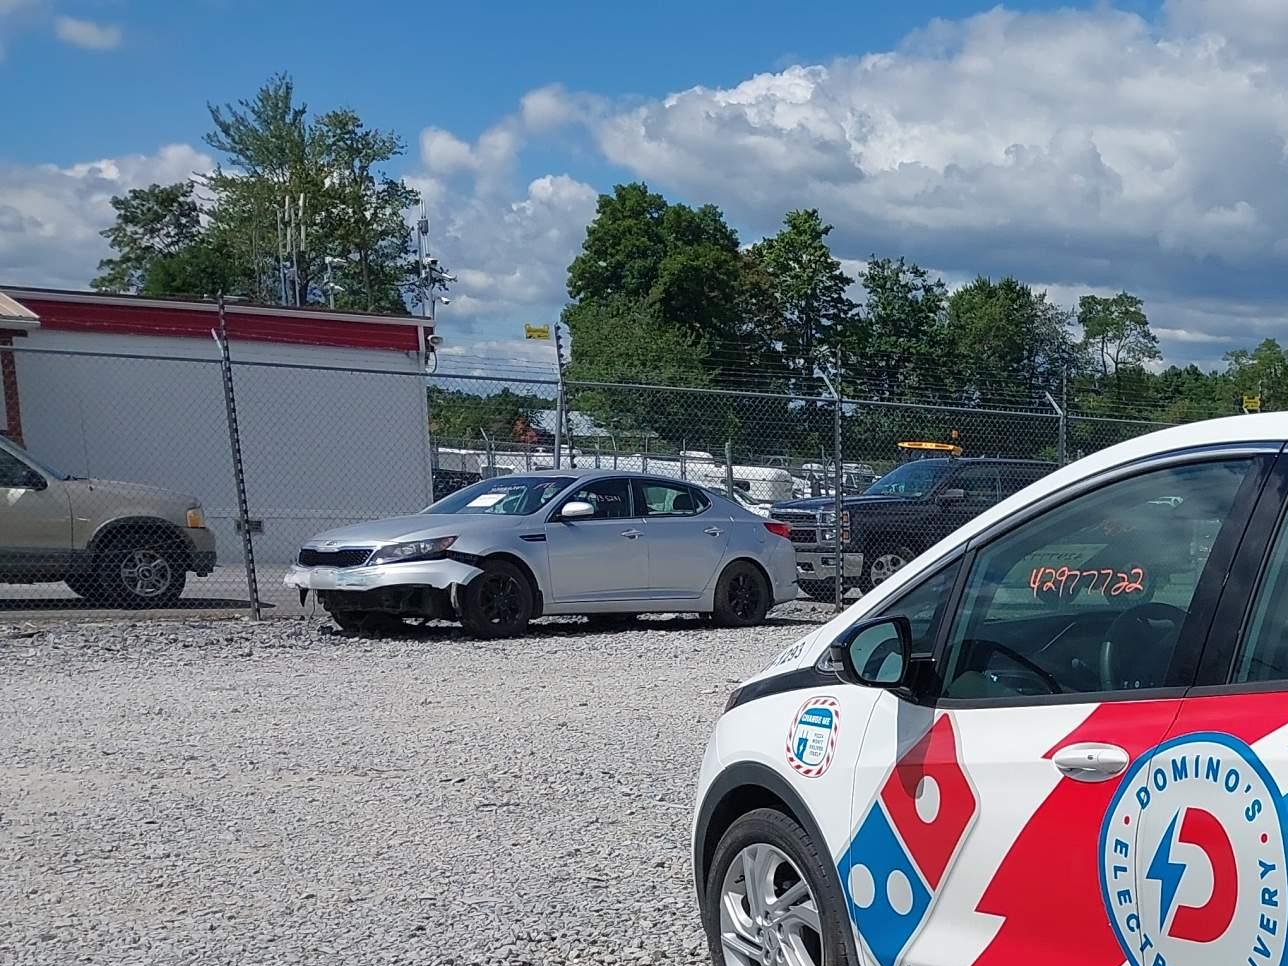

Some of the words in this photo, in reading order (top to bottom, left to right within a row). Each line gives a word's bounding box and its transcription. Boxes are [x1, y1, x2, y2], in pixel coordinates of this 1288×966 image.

[1030, 566, 1144, 599] 42977722
[822, 717, 831, 726] ME
[1136, 755, 1263, 822] DOMINO'S
